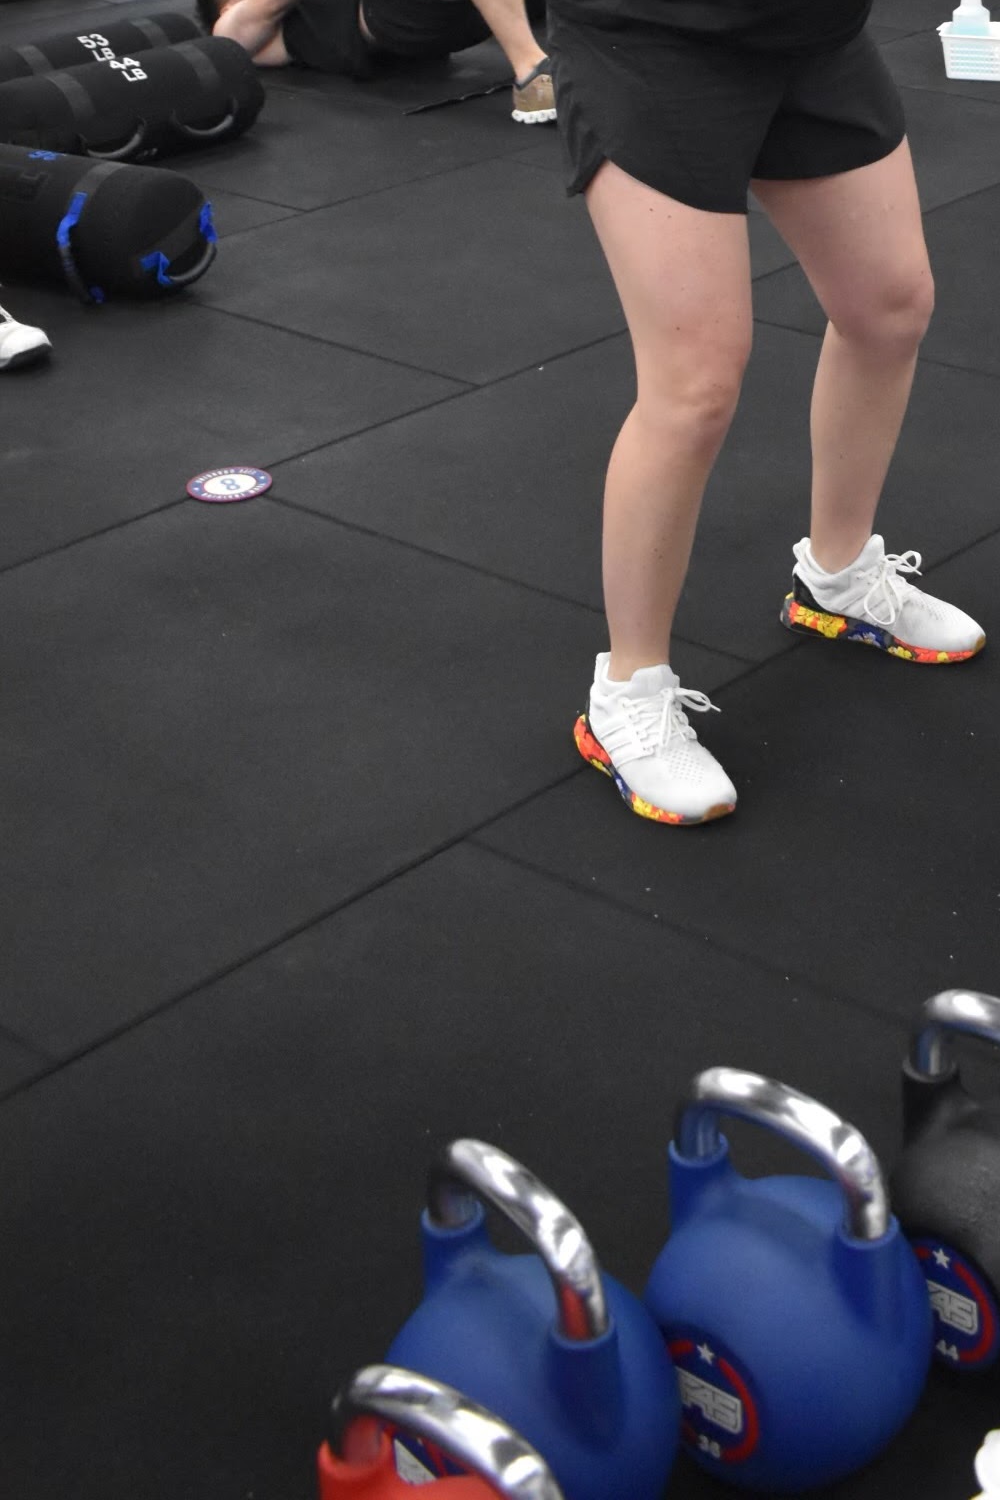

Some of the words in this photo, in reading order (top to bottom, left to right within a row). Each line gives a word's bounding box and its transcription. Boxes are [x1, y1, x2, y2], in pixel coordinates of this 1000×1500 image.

[76, 33, 110, 49] 53
[92, 47, 116, 62] LB
[109, 57, 141, 70] 44
[121, 68, 148, 82] LB
[935, 1339, 960, 1362] 44
